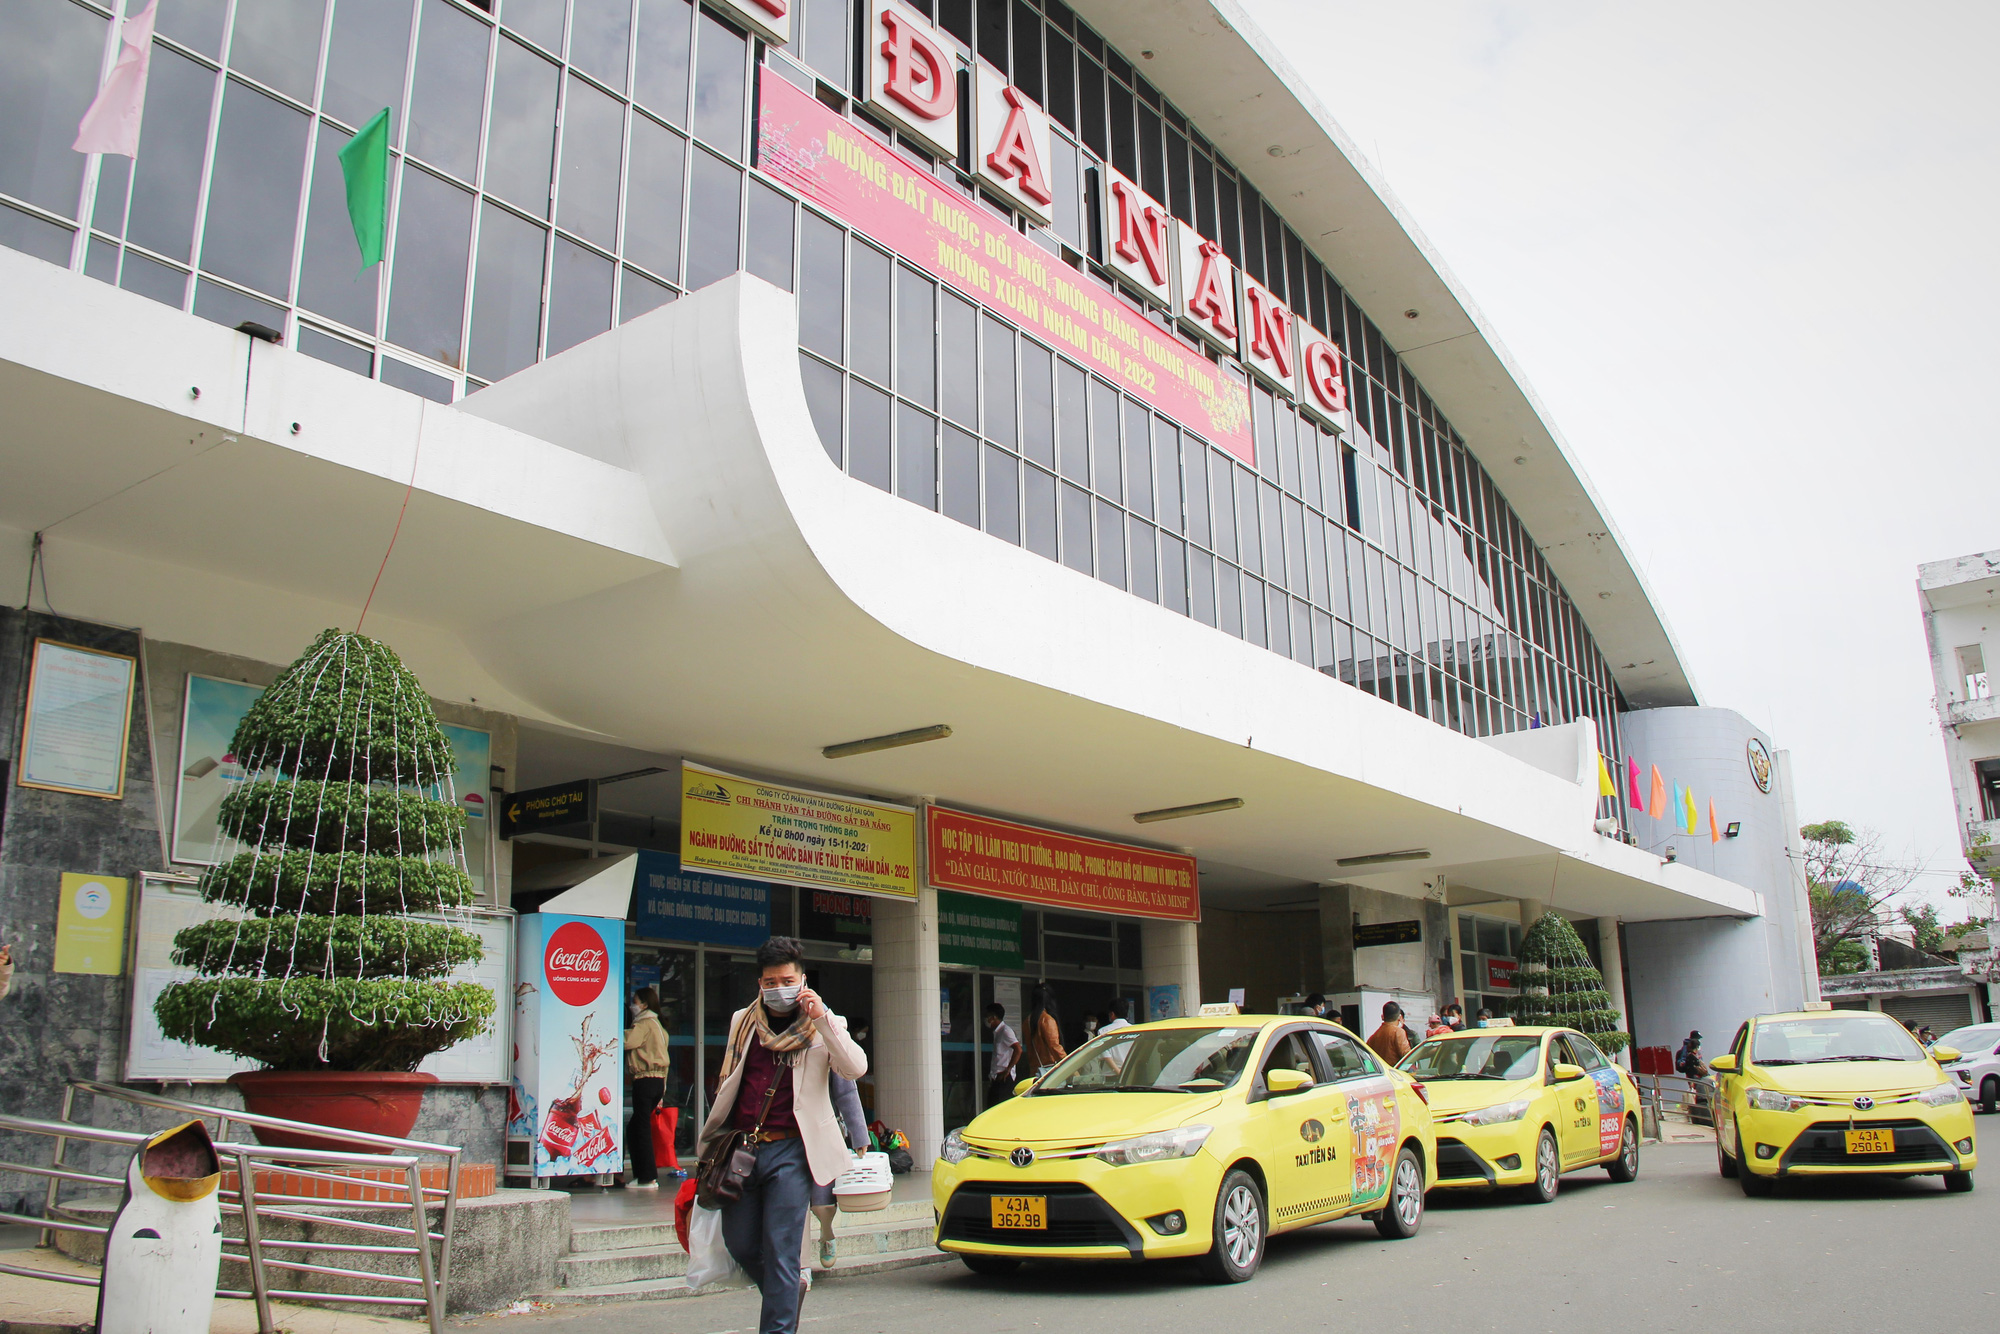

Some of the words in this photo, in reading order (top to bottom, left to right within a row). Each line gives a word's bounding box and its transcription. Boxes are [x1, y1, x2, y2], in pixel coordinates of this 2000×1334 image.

[881, 9, 1052, 206] ĐÀ
[1112, 180, 1346, 412] NẴNG
[827, 129, 887, 191] MỪNG
[892, 176, 927, 215] ĐẤT
[933, 198, 981, 249] NƯỚC
[985, 231, 1014, 268] ĐỔI
[1016, 246, 1053, 295] MỚI,
[1055, 274, 1100, 320] MỪNG
[1102, 300, 1140, 347] ĐẢNG
[1142, 331, 1186, 378] QUANG
[1187, 360, 1216, 397] VINH
[937, 239, 991, 293] MỪNG
[995, 271, 1039, 324] XUÂN
[1043, 299, 1088, 351] NHÂM
[1091, 329, 1122, 373] DẦN
[1124, 355, 1156, 395] 2022
[526, 798, 550, 811] PHÒNG
[552, 793, 567, 807] CHỜ
[569, 791, 583, 803] TÀU
[736, 795, 751, 805] CHI
[753, 797, 782, 812] NHÁNH
[783, 804, 799, 815] VẬN
[802, 806, 815, 817] TẢI
[817, 809, 842, 823] ĐƯỜNG
[844, 813, 859, 825] SẮT
[860, 817, 870, 828] ĐÀ
[757, 788, 773, 798] CÔNG
[782, 792, 790, 802] CỔ
[806, 797, 817, 807] VẬN
[827, 802, 845, 812] ĐƯỜNG
[759, 824, 773, 837] Kể
[774, 827, 783, 838] từ
[784, 830, 805, 842] 8h00
[806, 835, 826, 847] ngày
[772, 815, 792, 826] TRÂN
[794, 819, 818, 832] TRỌNG
[819, 823, 842, 835] THÔNG
[689, 828, 718, 850] NGÀNH
[719, 833, 747, 855] ĐƯỜNG
[748, 835, 763, 857] SẮT
[765, 837, 775, 859] TỔ
[776, 843, 797, 862] CHỨC
[798, 846, 813, 864] BÁN
[815, 847, 824, 867] VÉ
[825, 849, 839, 869] TÀU
[841, 850, 854, 871] TẾT
[855, 856, 875, 874] NHÂM
[876, 856, 890, 876] DẦN
[895, 863, 910, 879] 2022
[941, 828, 957, 854] HỌC
[958, 828, 973, 856] TẬP
[974, 831, 984, 855] VÀ
[985, 833, 1001, 859] LÀM
[1002, 840, 1020, 862] THEO
[1020, 843, 1029, 864] TƯ
[1030, 841, 1054, 870] TƯỞNG,
[1055, 850, 1068, 873] ĐẠO
[1069, 850, 1084, 876] ĐỨC,
[1085, 855, 1106, 877] PHONG
[1107, 856, 1123, 879] CÁCH
[1123, 857, 1132, 880] HỒ
[1132, 861, 1143, 882] CHÍ
[1143, 865, 1159, 884] MINH
[1159, 865, 1165, 885] VÌ
[1165, 868, 1178, 890] MỤC
[649, 873, 666, 891] THỰC
[666, 874, 682, 894] HIỆN
[683, 878, 692, 893] 5K
[713, 883, 723, 897] AN
[724, 882, 740, 899] TOÀN
[740, 886, 753, 901] CHO
[753, 889, 766, 904] BẠN
[973, 862, 1001, 886] GIÀU,
[1002, 868, 1029, 888] NƯỚC
[1030, 875, 1060, 894] MẠNH,
[1061, 876, 1079, 895] DÂN
[1081, 879, 1102, 901] CHỦ,
[1103, 882, 1126, 902] CÔNG
[1126, 883, 1151, 907] BẰNG,
[1151, 890, 1167, 906] VĂN
[657, 898, 675, 919] CỘNG
[694, 903, 713, 921] TRƯỚC
[714, 907, 725, 926] ĐẠI
[726, 909, 740, 927] DỊCH
[740, 911, 766, 927] COVID-19
[549, 947, 604, 972] Coca-Cola
[1203, 1006, 1230, 1014] TAXI
[546, 1120, 576, 1143] Coca-Cola
[1600, 1117, 1619, 1133] ENEOS
[1859, 1131, 1879, 1141] 43A
[1295, 1153, 1309, 1167] TAXI
[1309, 1145, 1326, 1165] TIÊN
[1327, 1146, 1337, 1162] SA
[1851, 1141, 1888, 1152] 250.61
[1007, 1198, 1030, 1211] 43A
[997, 1213, 1041, 1227] 362.98
